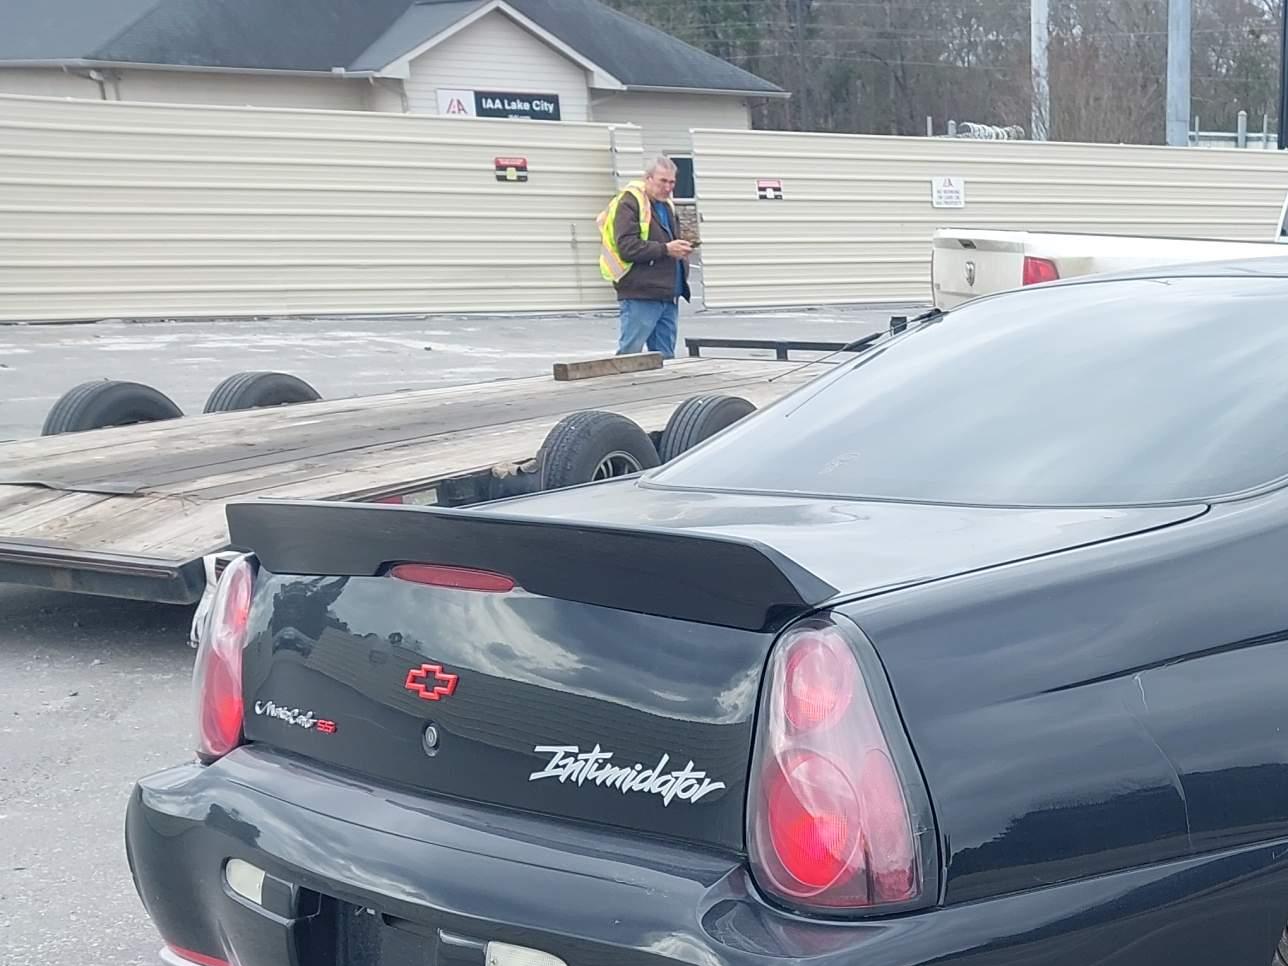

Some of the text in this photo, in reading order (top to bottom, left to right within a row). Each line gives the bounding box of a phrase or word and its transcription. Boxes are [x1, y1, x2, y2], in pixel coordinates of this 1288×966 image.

[482, 98, 554, 113] IAA Lake City
[528, 743, 726, 807] Intimidator
